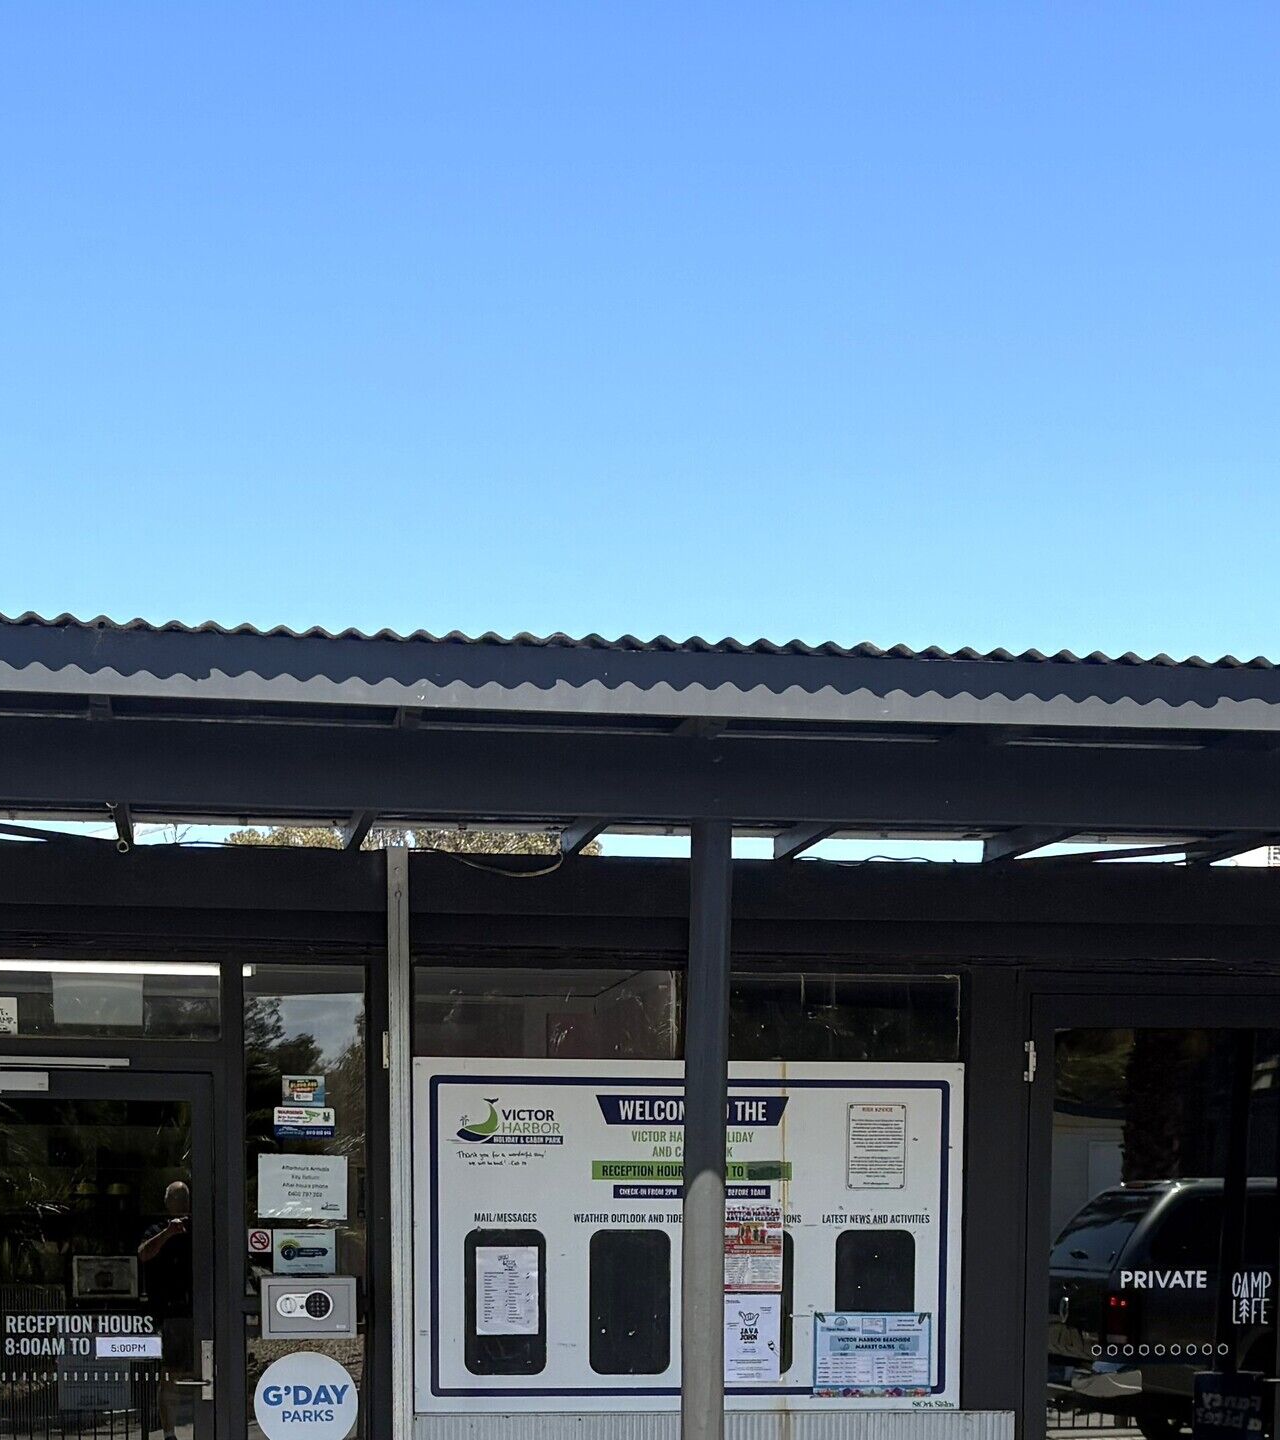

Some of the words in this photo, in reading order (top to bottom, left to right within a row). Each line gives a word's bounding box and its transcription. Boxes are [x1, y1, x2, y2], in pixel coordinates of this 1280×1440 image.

[502, 1109, 555, 1121] VICTOR
[619, 1100, 685, 1121] WELCO
[734, 1101, 767, 1122] THE
[502, 1122, 560, 1134] HARBOR
[545, 1136, 562, 1144] PARK
[631, 1130, 667, 1143] VICTOR
[726, 1130, 755, 1143] LIDAY
[652, 1146, 673, 1158] AND
[602, 1165, 654, 1177] RECEPTION
[657, 1165, 684, 1177] HOUR
[732, 1165, 744, 1177] TO
[474, 1213, 538, 1222] MAIL/MESSAGES
[573, 1213, 609, 1223] WEATHER
[611, 1213, 647, 1223] OUTLOOK
[648, 1213, 664, 1223] AND
[822, 1214, 848, 1224] LATEST
[849, 1214, 871, 1224] NEWS
[873, 1214, 889, 1224] AND
[890, 1214, 931, 1224] ACTIVITIES
[1120, 1270, 1207, 1289] PRIVATE
[1232, 1271, 1272, 1298] CAMP
[5, 1315, 93, 1333] RECEPTION
[98, 1315, 154, 1333] HOURS
[5, 1338, 65, 1356] 8:00AM
[70, 1338, 90, 1355] TO
[111, 1343, 146, 1353] 5:00PM
[263, 1384, 349, 1406] G'DAY
[282, 1409, 334, 1422] PARKS
